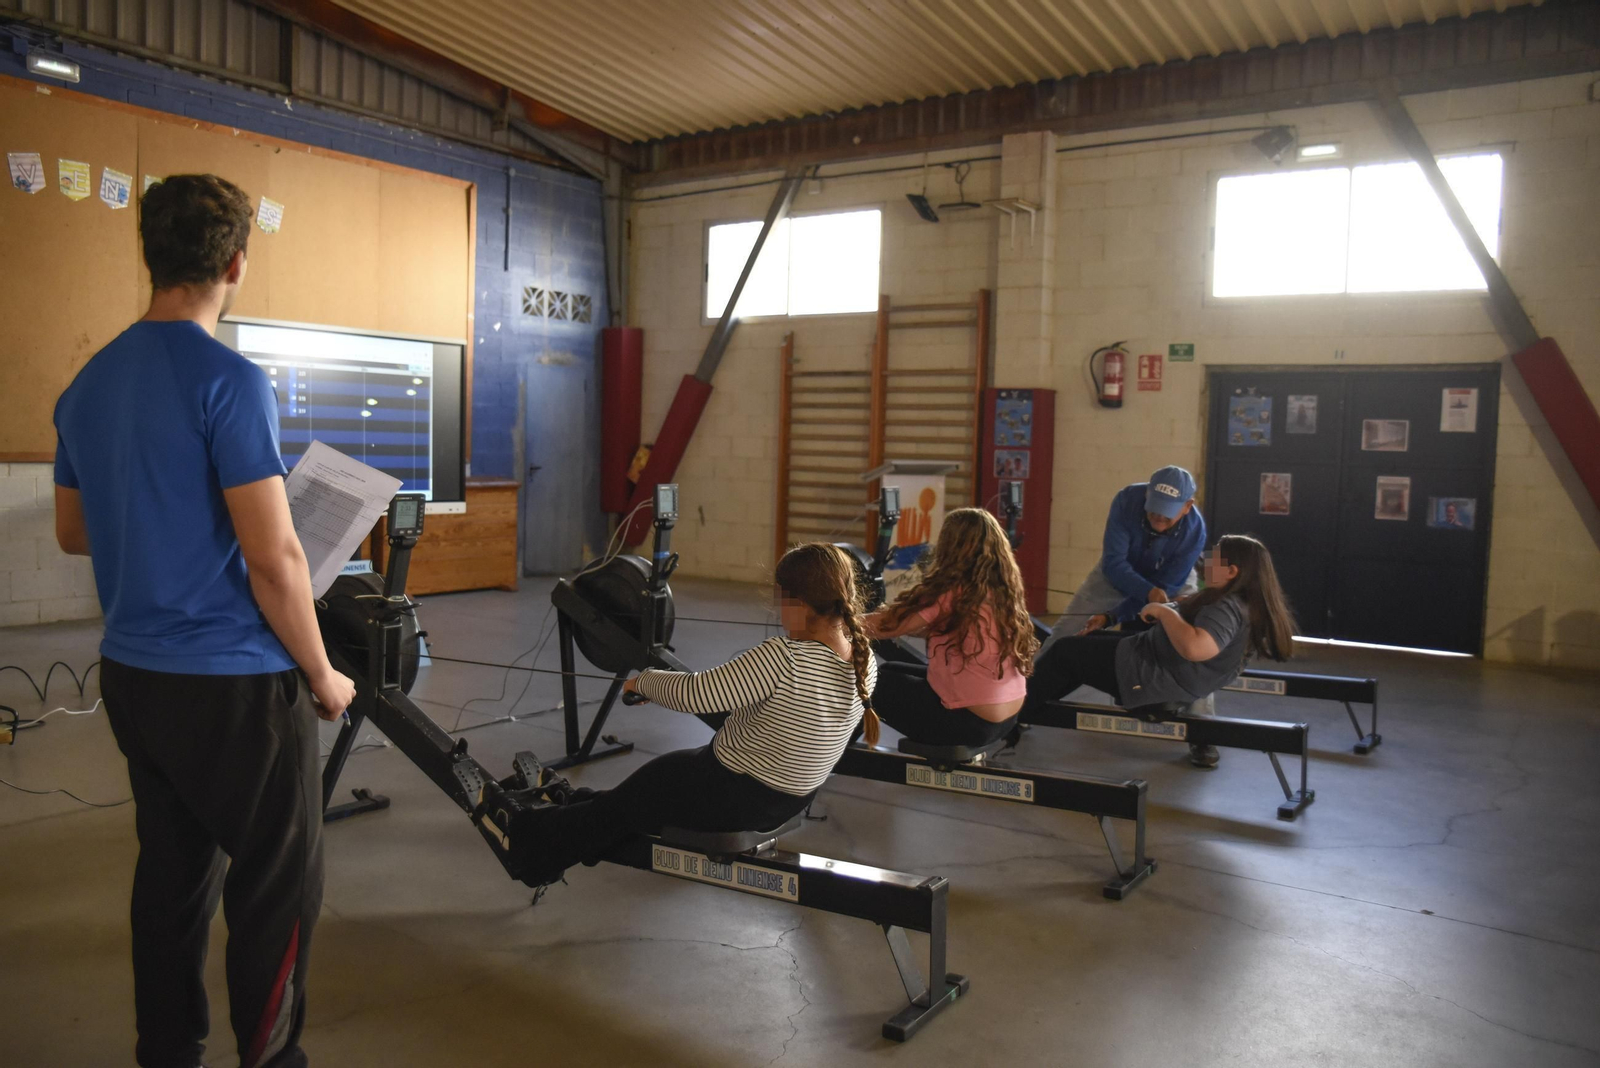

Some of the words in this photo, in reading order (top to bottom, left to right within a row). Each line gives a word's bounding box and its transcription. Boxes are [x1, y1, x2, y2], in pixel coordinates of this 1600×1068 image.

[16, 163, 37, 184] V
[73, 169, 88, 192] E
[103, 179, 121, 202] N
[265, 208, 277, 226] S
[341, 563, 367, 573] INENSE
[907, 767, 931, 785] CLUB
[935, 770, 947, 786] DE
[950, 773, 977, 790] REMO
[981, 777, 1021, 796] LINENSE
[1024, 783, 1032, 798] 3
[653, 848, 680, 870] CLUB
[683, 854, 699, 875] DE
[701, 858, 733, 882] REMO
[736, 865, 784, 893] LINENSE
[787, 876, 797, 896] 4
